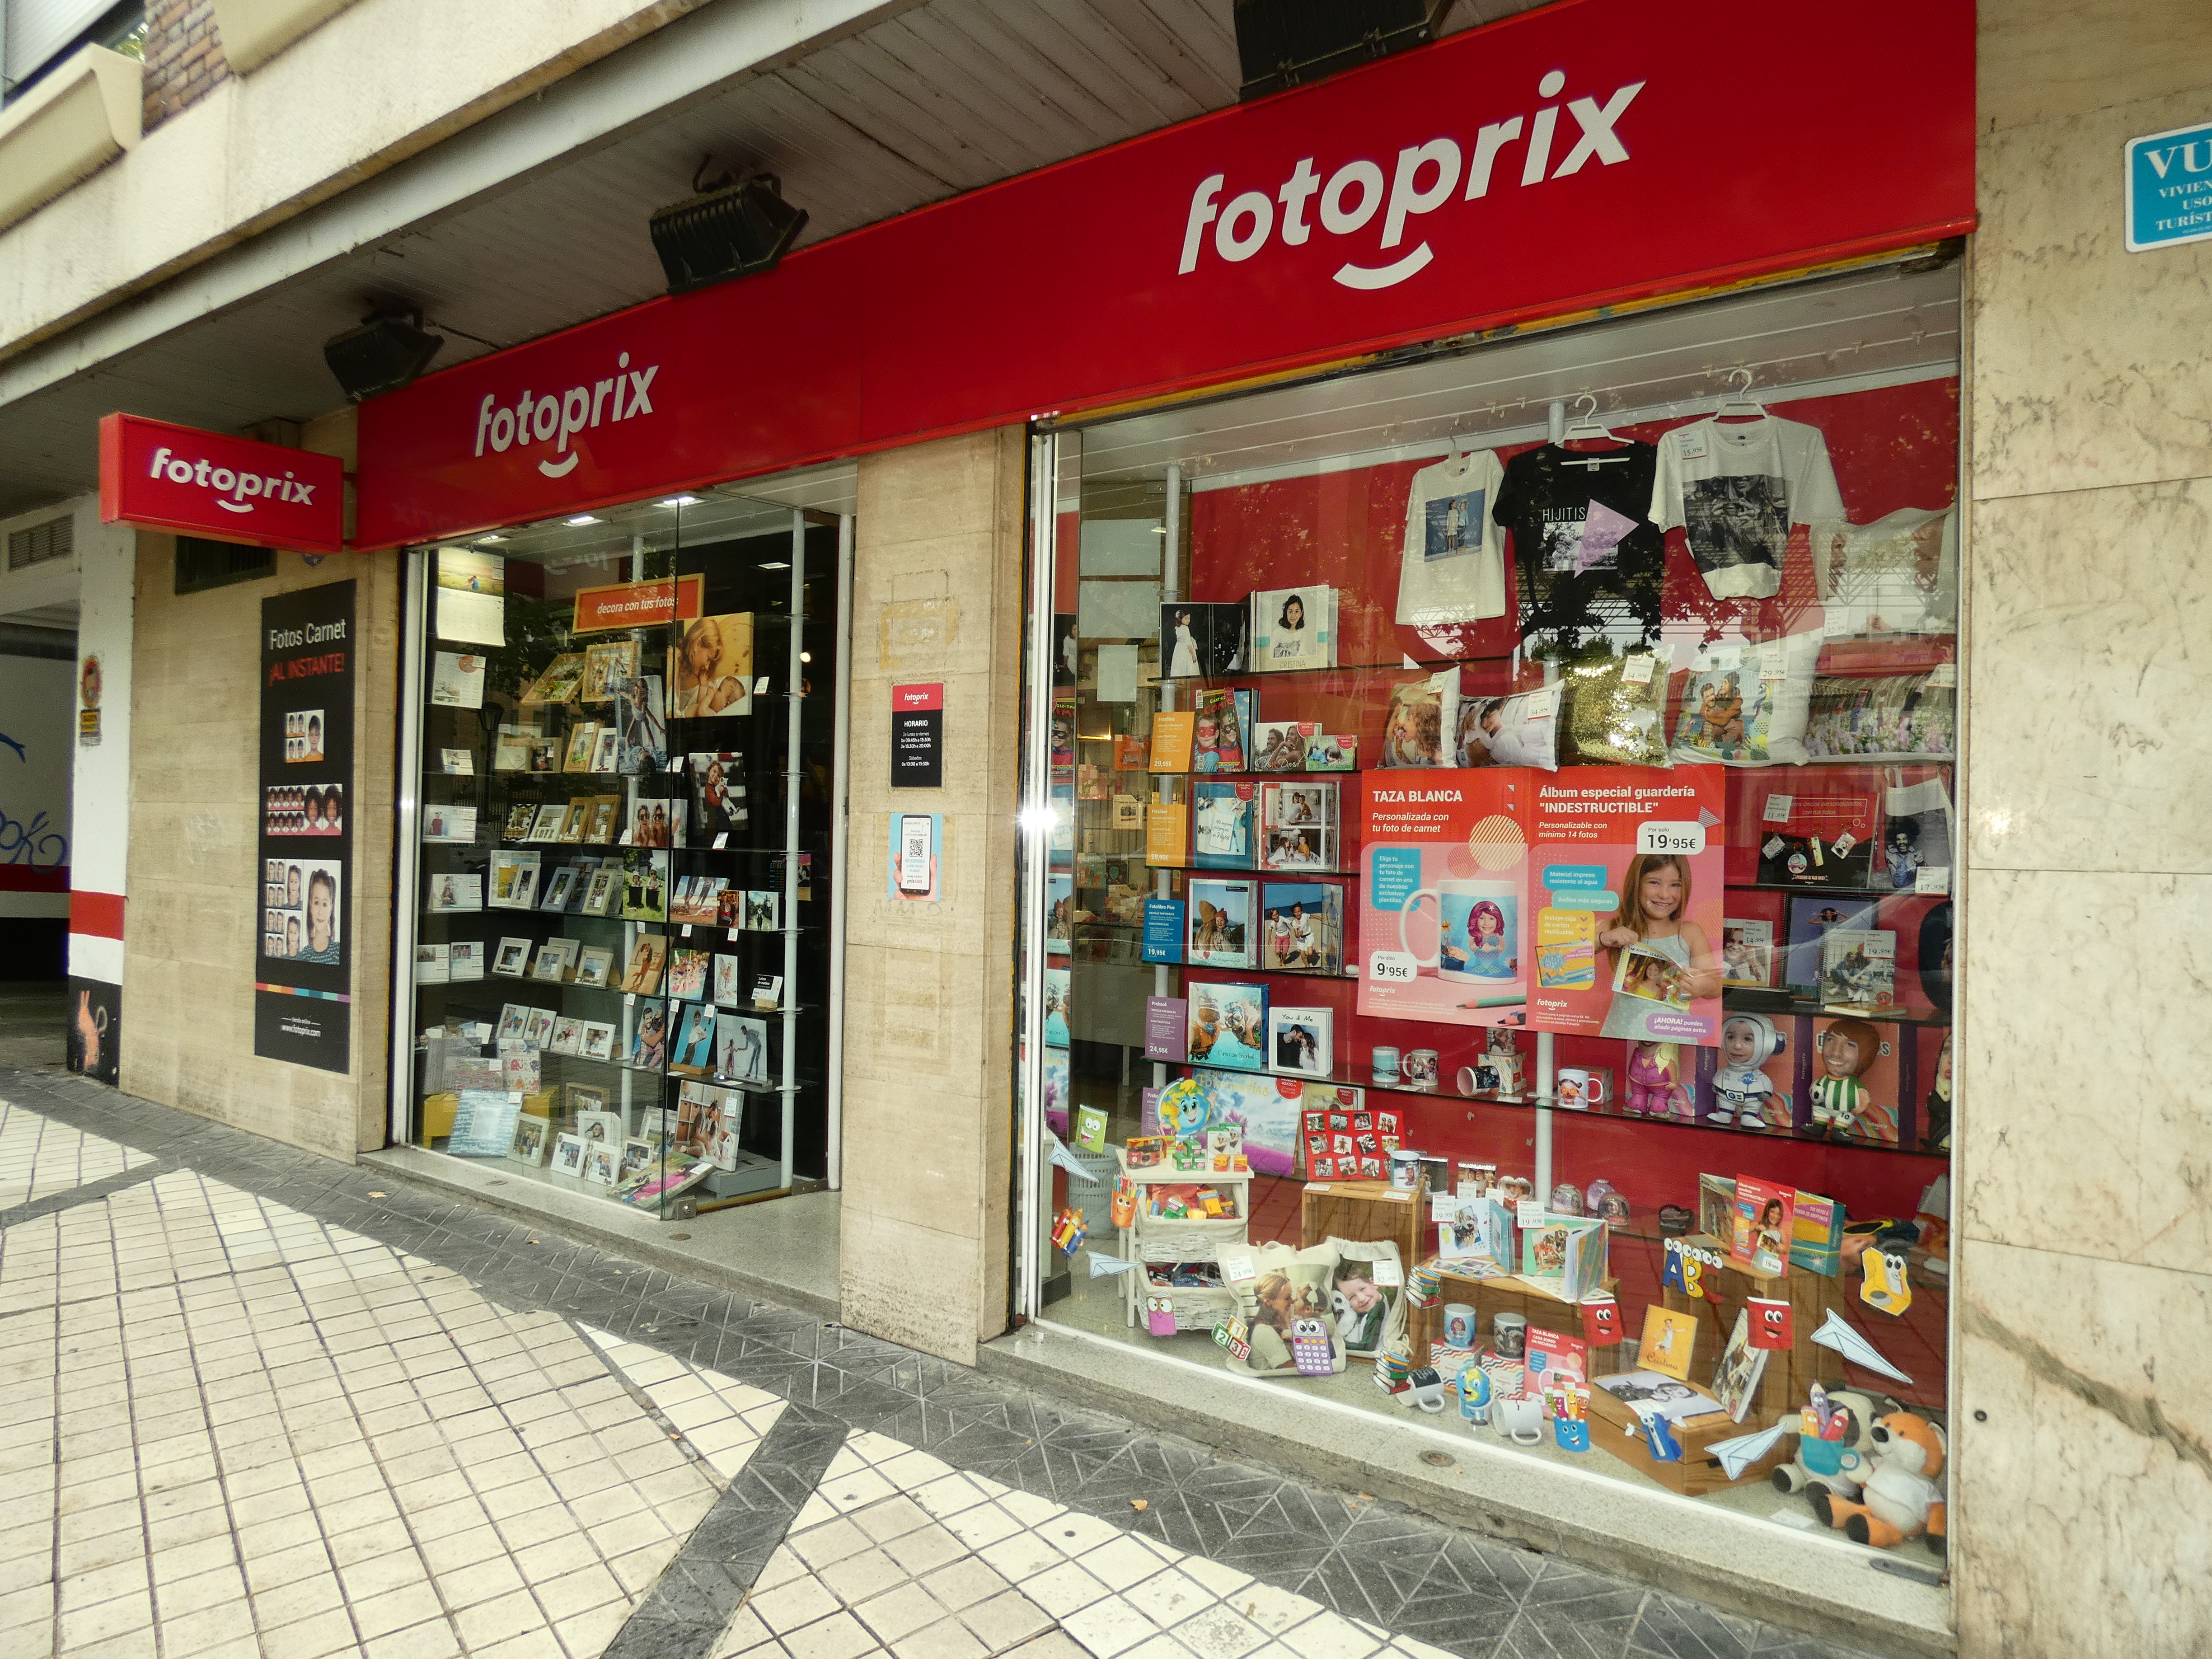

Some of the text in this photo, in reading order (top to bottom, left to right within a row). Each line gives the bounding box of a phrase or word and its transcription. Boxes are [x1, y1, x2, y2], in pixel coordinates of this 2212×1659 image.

[1178, 70, 1646, 276] fotoprix
[2182, 196, 2212, 210] USO
[475, 352, 660, 457] fotoprix
[150, 447, 317, 506] fotoprix
[1542, 507, 1585, 521] HIJITIS
[597, 595, 679, 614] decora con tus fotos
[269, 618, 347, 650] Fotos Carnet
[1280, 660, 1306, 669] CRISTINA
[904, 692, 929, 702] fotoprix
[1373, 790, 1463, 802] TAZA BLANCA
[1539, 785, 1695, 800] Álbum especial guardería
[1539, 802, 1659, 813] "INDESTRUCTIBLE"
[1372, 812, 1431, 821] Personalizada
[1382, 824, 1399, 832] foto
[1401, 824, 1411, 832] de
[1648, 834, 1696, 849] 19'95€
[1377, 963, 1408, 977] 9'95€
[1370, 985, 1396, 994] fotoprix
[1537, 998, 1568, 1008] fotoprix
[1150, 1045, 1168, 1054] 24,95€
[1195, 1074, 1270, 1097] FOTOGRAFÍAS
[1840, 1112, 1850, 1120] 10
[1662, 1250, 1724, 1304] ABC
[1236, 1326, 1241, 1335] 1
[1542, 1331, 1559, 1340] BLANCA
[1218, 1332, 1226, 1342] 2
[1232, 1342, 1239, 1352] 3
[1537, 1340, 1557, 1349] RECUERDO
[1241, 1346, 1247, 1356] 3
[1647, 1352, 1678, 1370] Cristina
